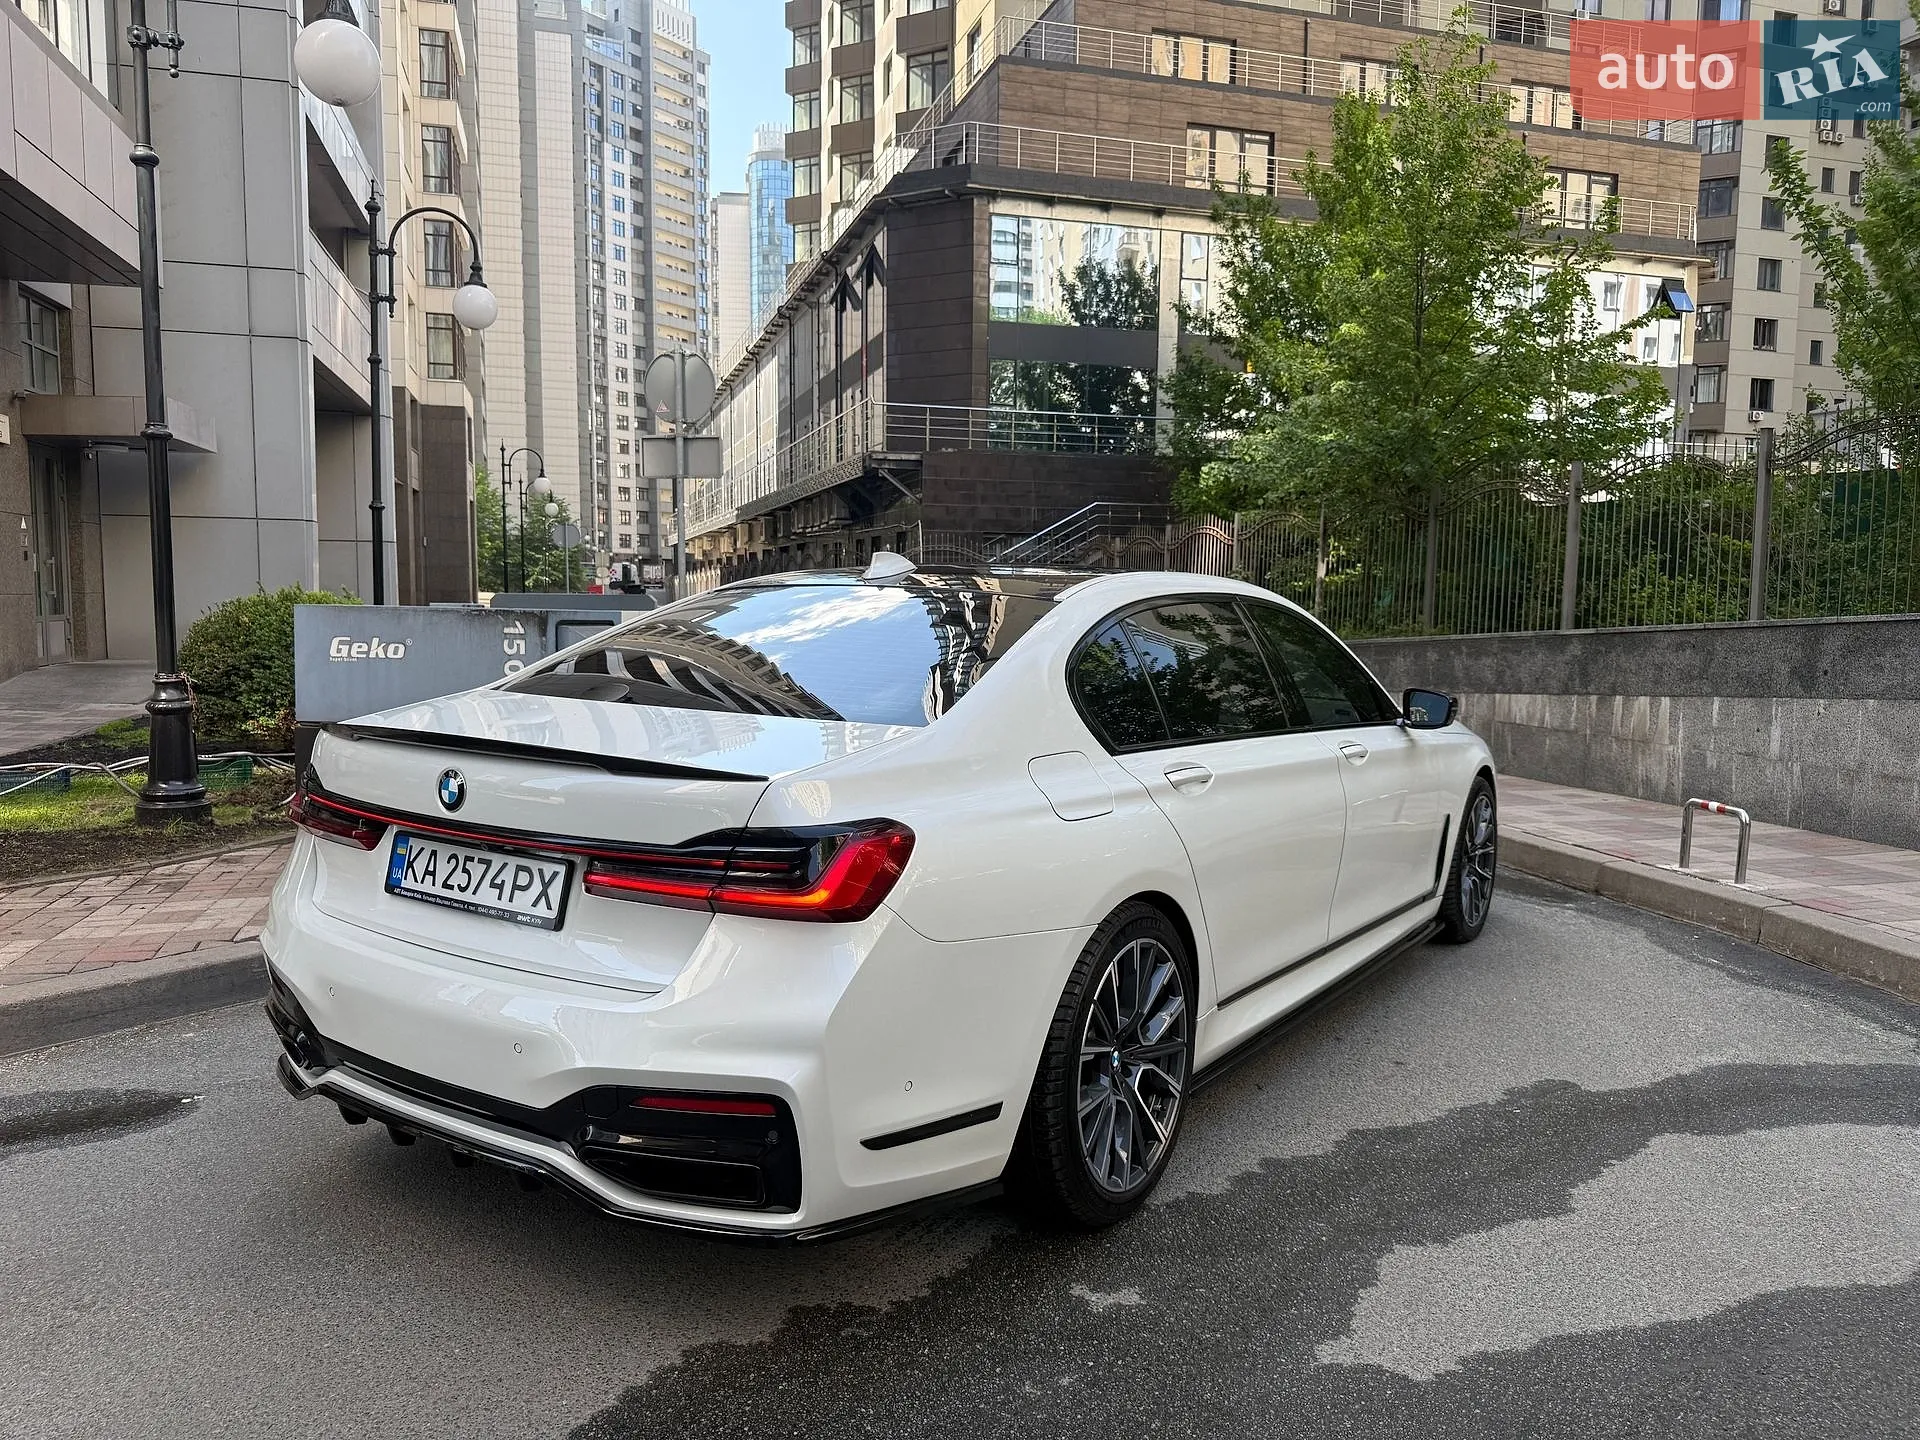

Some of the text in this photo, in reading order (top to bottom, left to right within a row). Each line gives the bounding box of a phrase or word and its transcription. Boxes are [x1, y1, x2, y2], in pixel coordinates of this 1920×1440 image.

[329, 636, 406, 659] Geko
[392, 867, 402, 880] UA
[403, 845, 561, 912] KA 2574 PX
